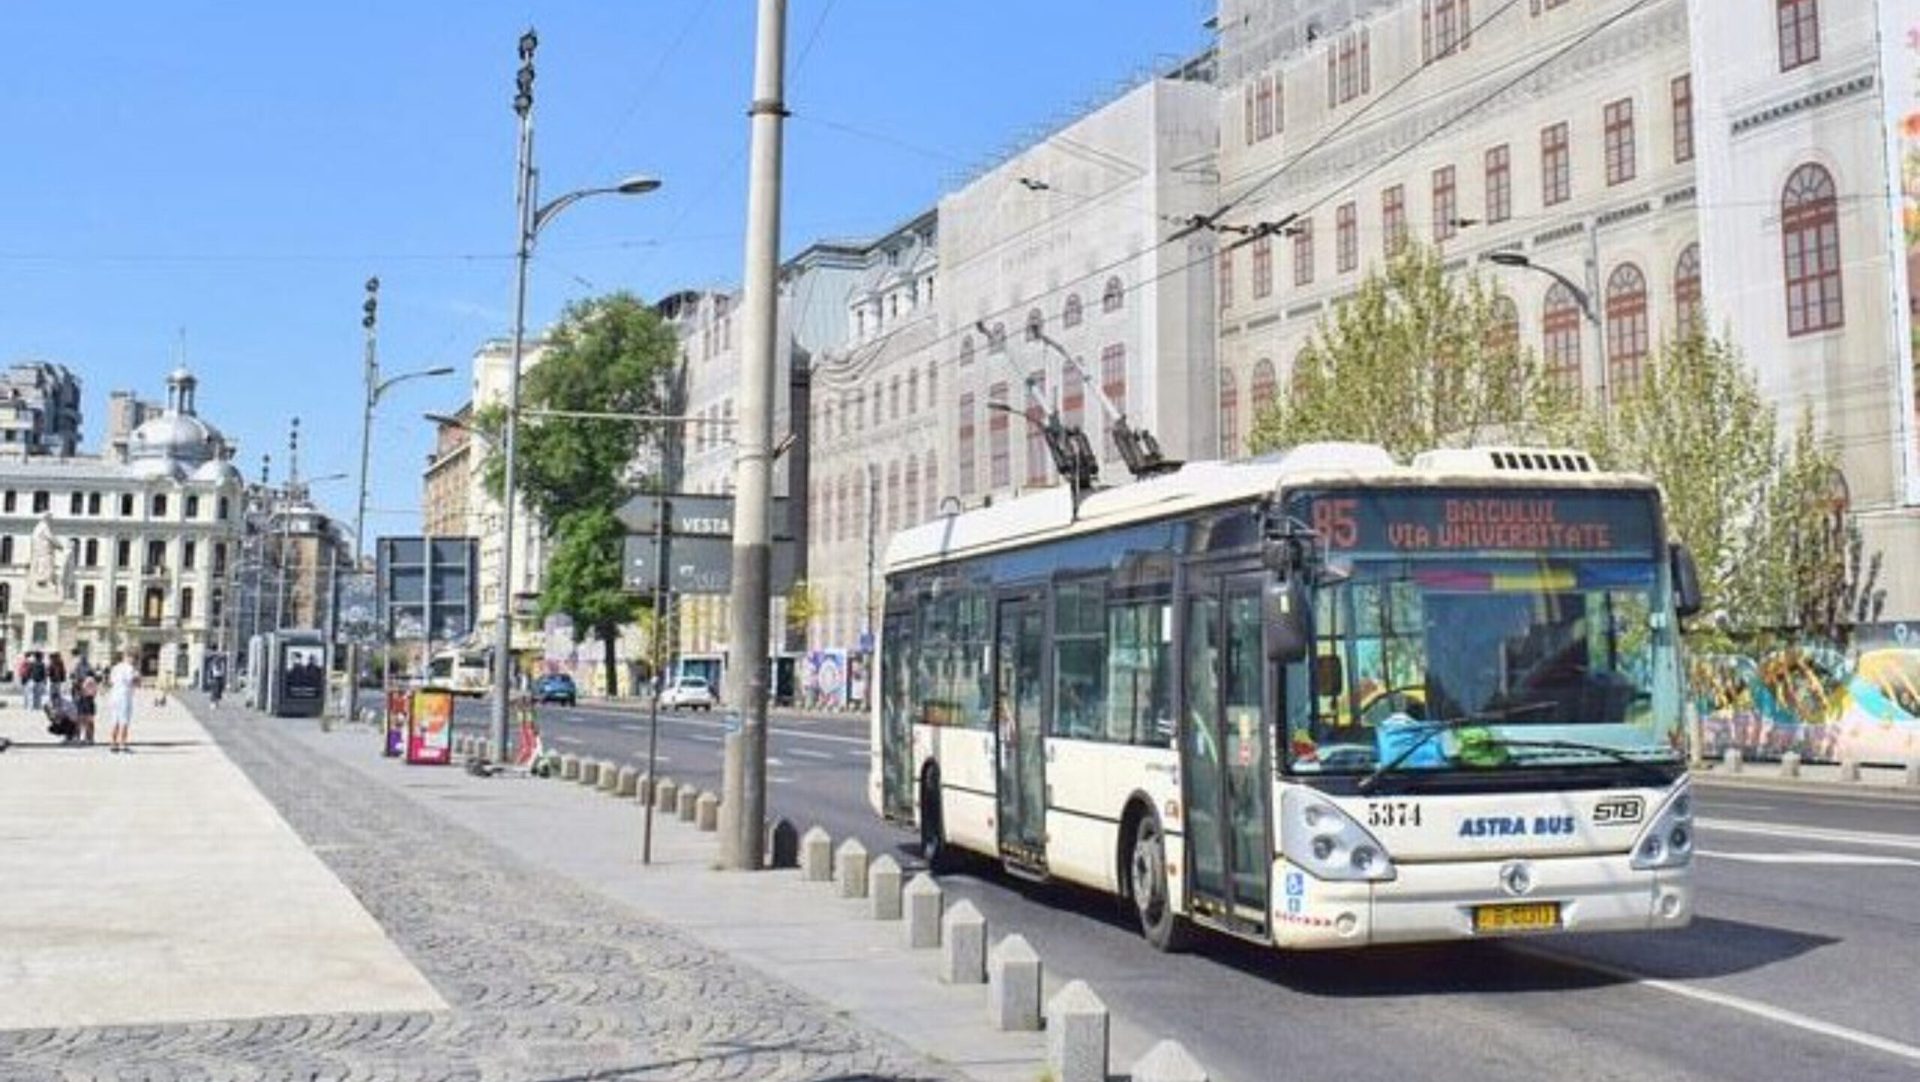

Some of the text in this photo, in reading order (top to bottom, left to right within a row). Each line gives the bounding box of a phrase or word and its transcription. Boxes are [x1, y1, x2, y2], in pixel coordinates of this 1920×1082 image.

[682, 517, 730, 533] VESTA
[1312, 499, 1358, 547] 85
[1388, 523, 1610, 547] VIA UNIVERSITATE
[1368, 803, 1421, 827] 5374
[1593, 801, 1640, 821] STB
[1459, 817, 1575, 837] ASTRA BUS
